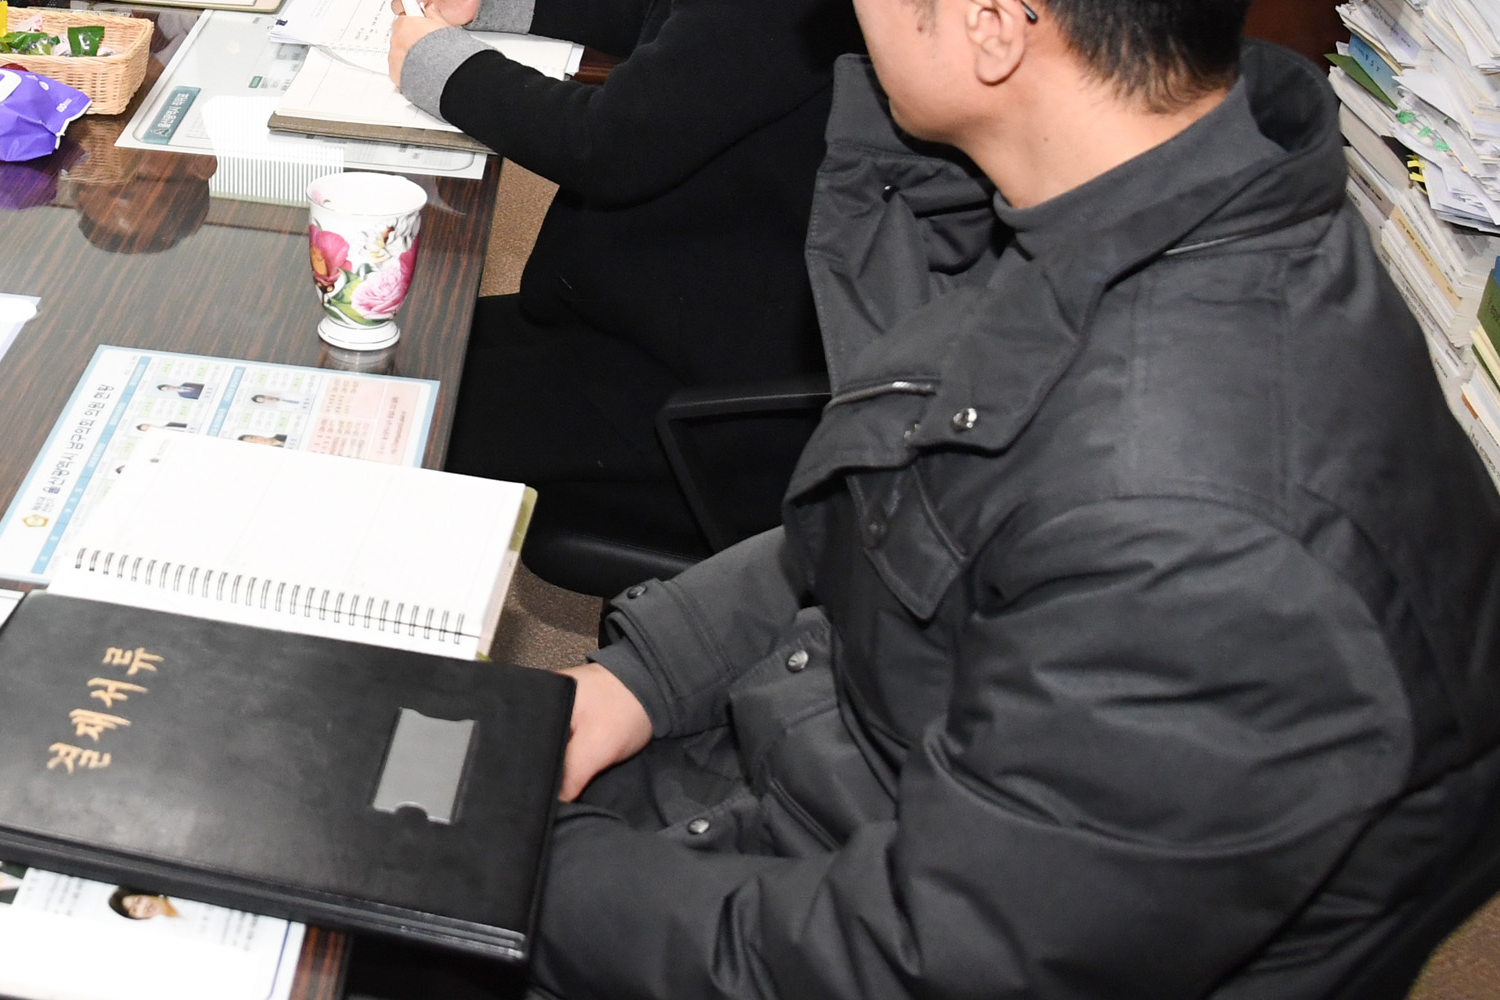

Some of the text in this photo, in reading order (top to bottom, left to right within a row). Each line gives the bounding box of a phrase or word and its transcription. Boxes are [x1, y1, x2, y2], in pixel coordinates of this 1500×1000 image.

[92, 384, 115, 400] 현황
[83, 401, 105, 417] 의원
[66, 418, 95, 450] 남구의회
[43, 452, 78, 494] 울산광역시
[46, 645, 164, 774] 결재서류
